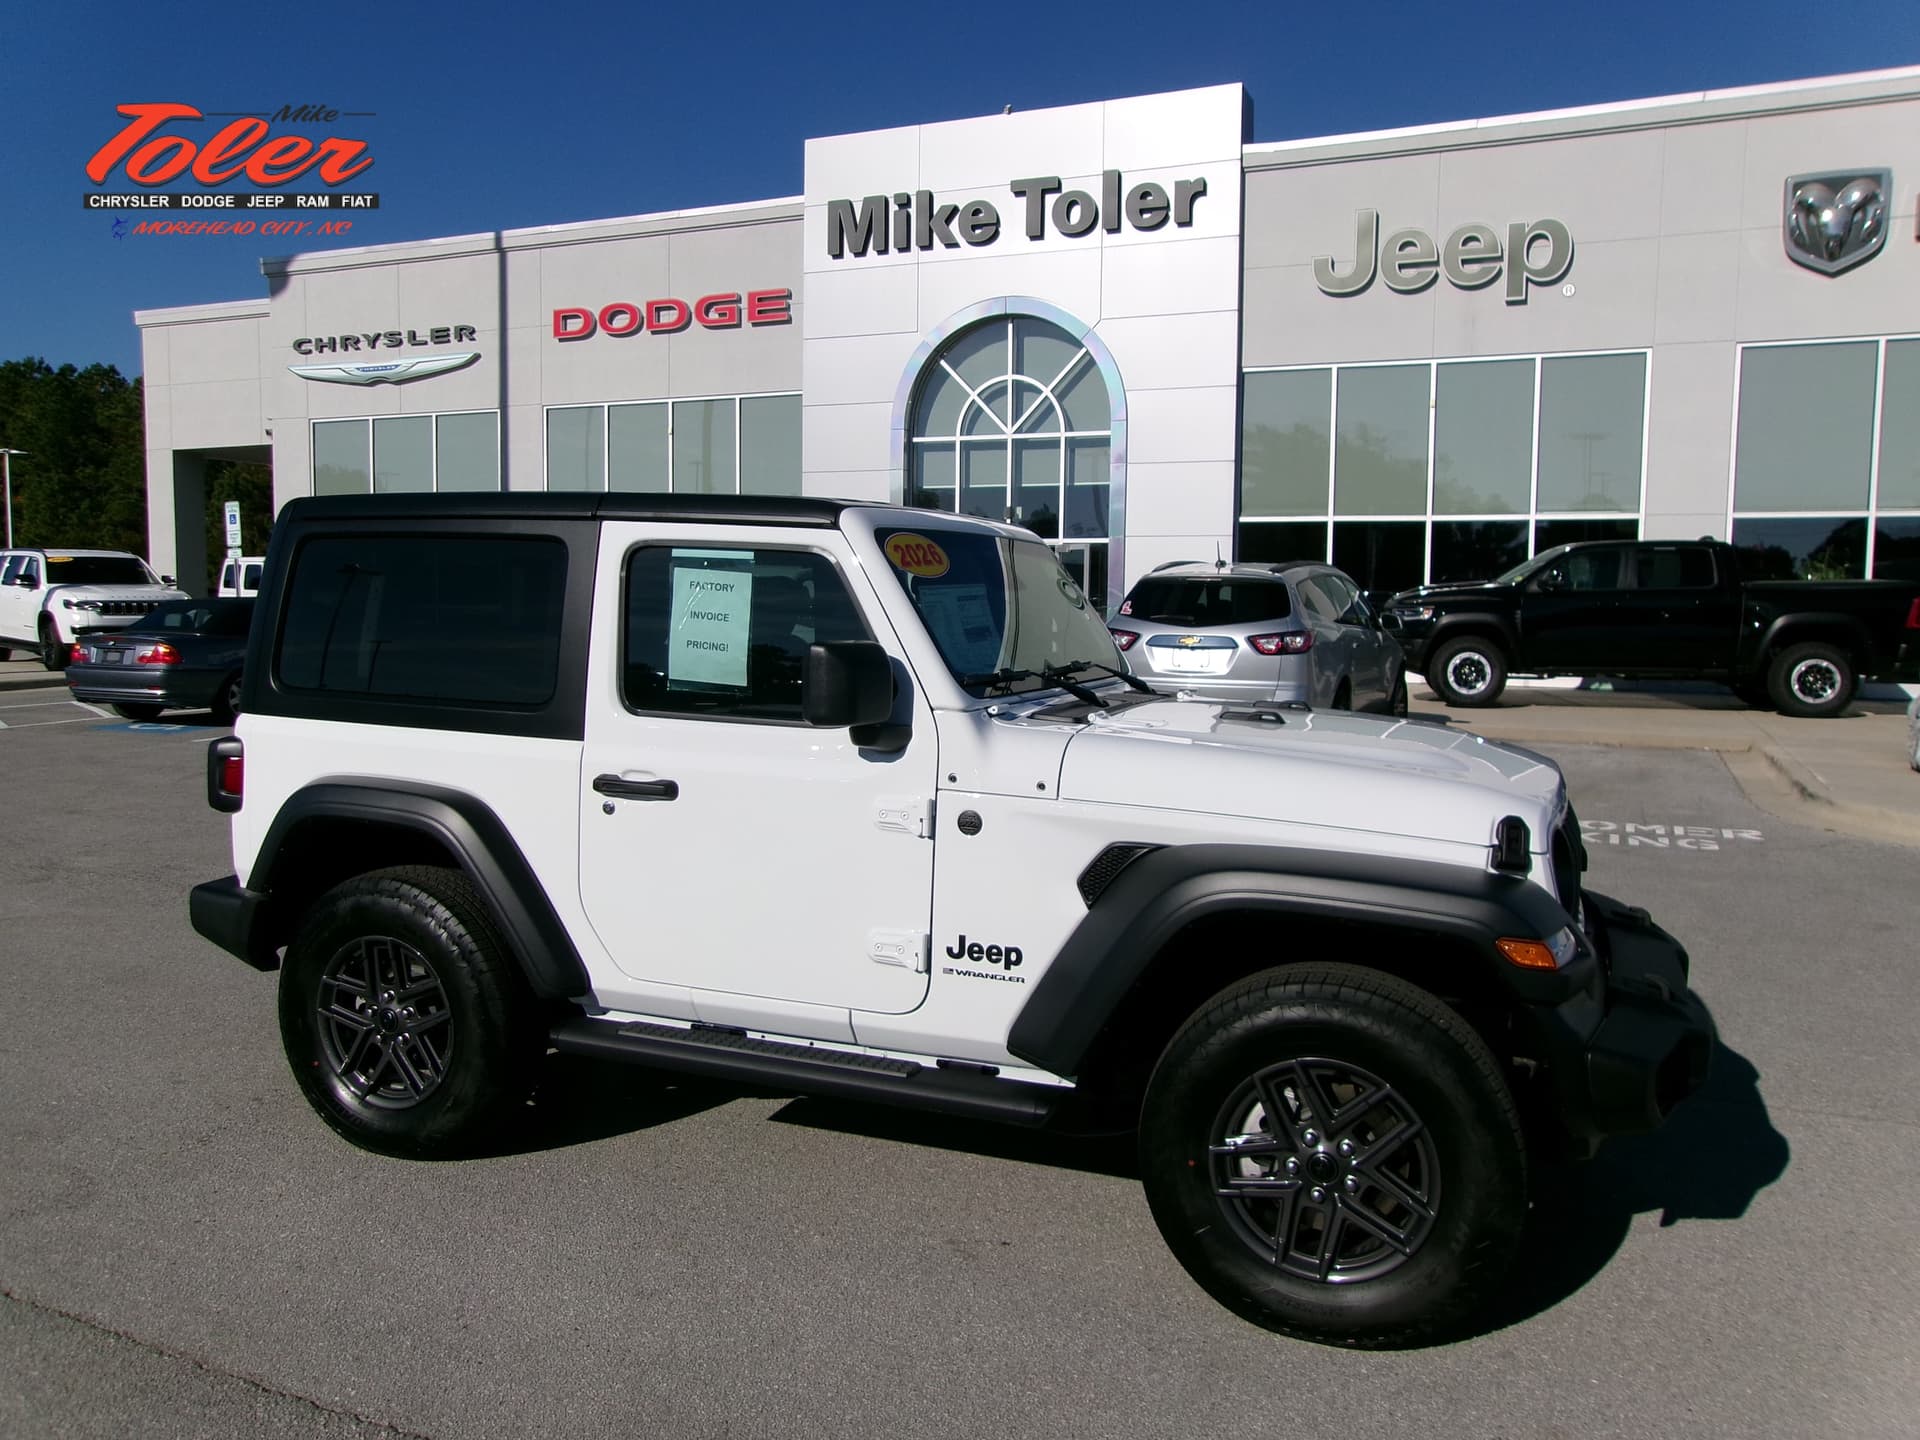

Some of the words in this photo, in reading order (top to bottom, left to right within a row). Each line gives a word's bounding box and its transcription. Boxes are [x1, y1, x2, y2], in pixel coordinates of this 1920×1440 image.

[827, 189, 1001, 260] Mike
[1010, 169, 1207, 242] Toler
[1311, 208, 1574, 306] Jeep
[553, 288, 792, 343] DODGE
[292, 324, 477, 355] CHRYSLER
[893, 543, 944, 568] 2026
[689, 580, 735, 592] FACTORY
[690, 610, 730, 622] INVOICE
[686, 639, 729, 652] PRICING!
[946, 934, 1023, 971] Jeep
[956, 968, 1025, 983] WRANGLER
